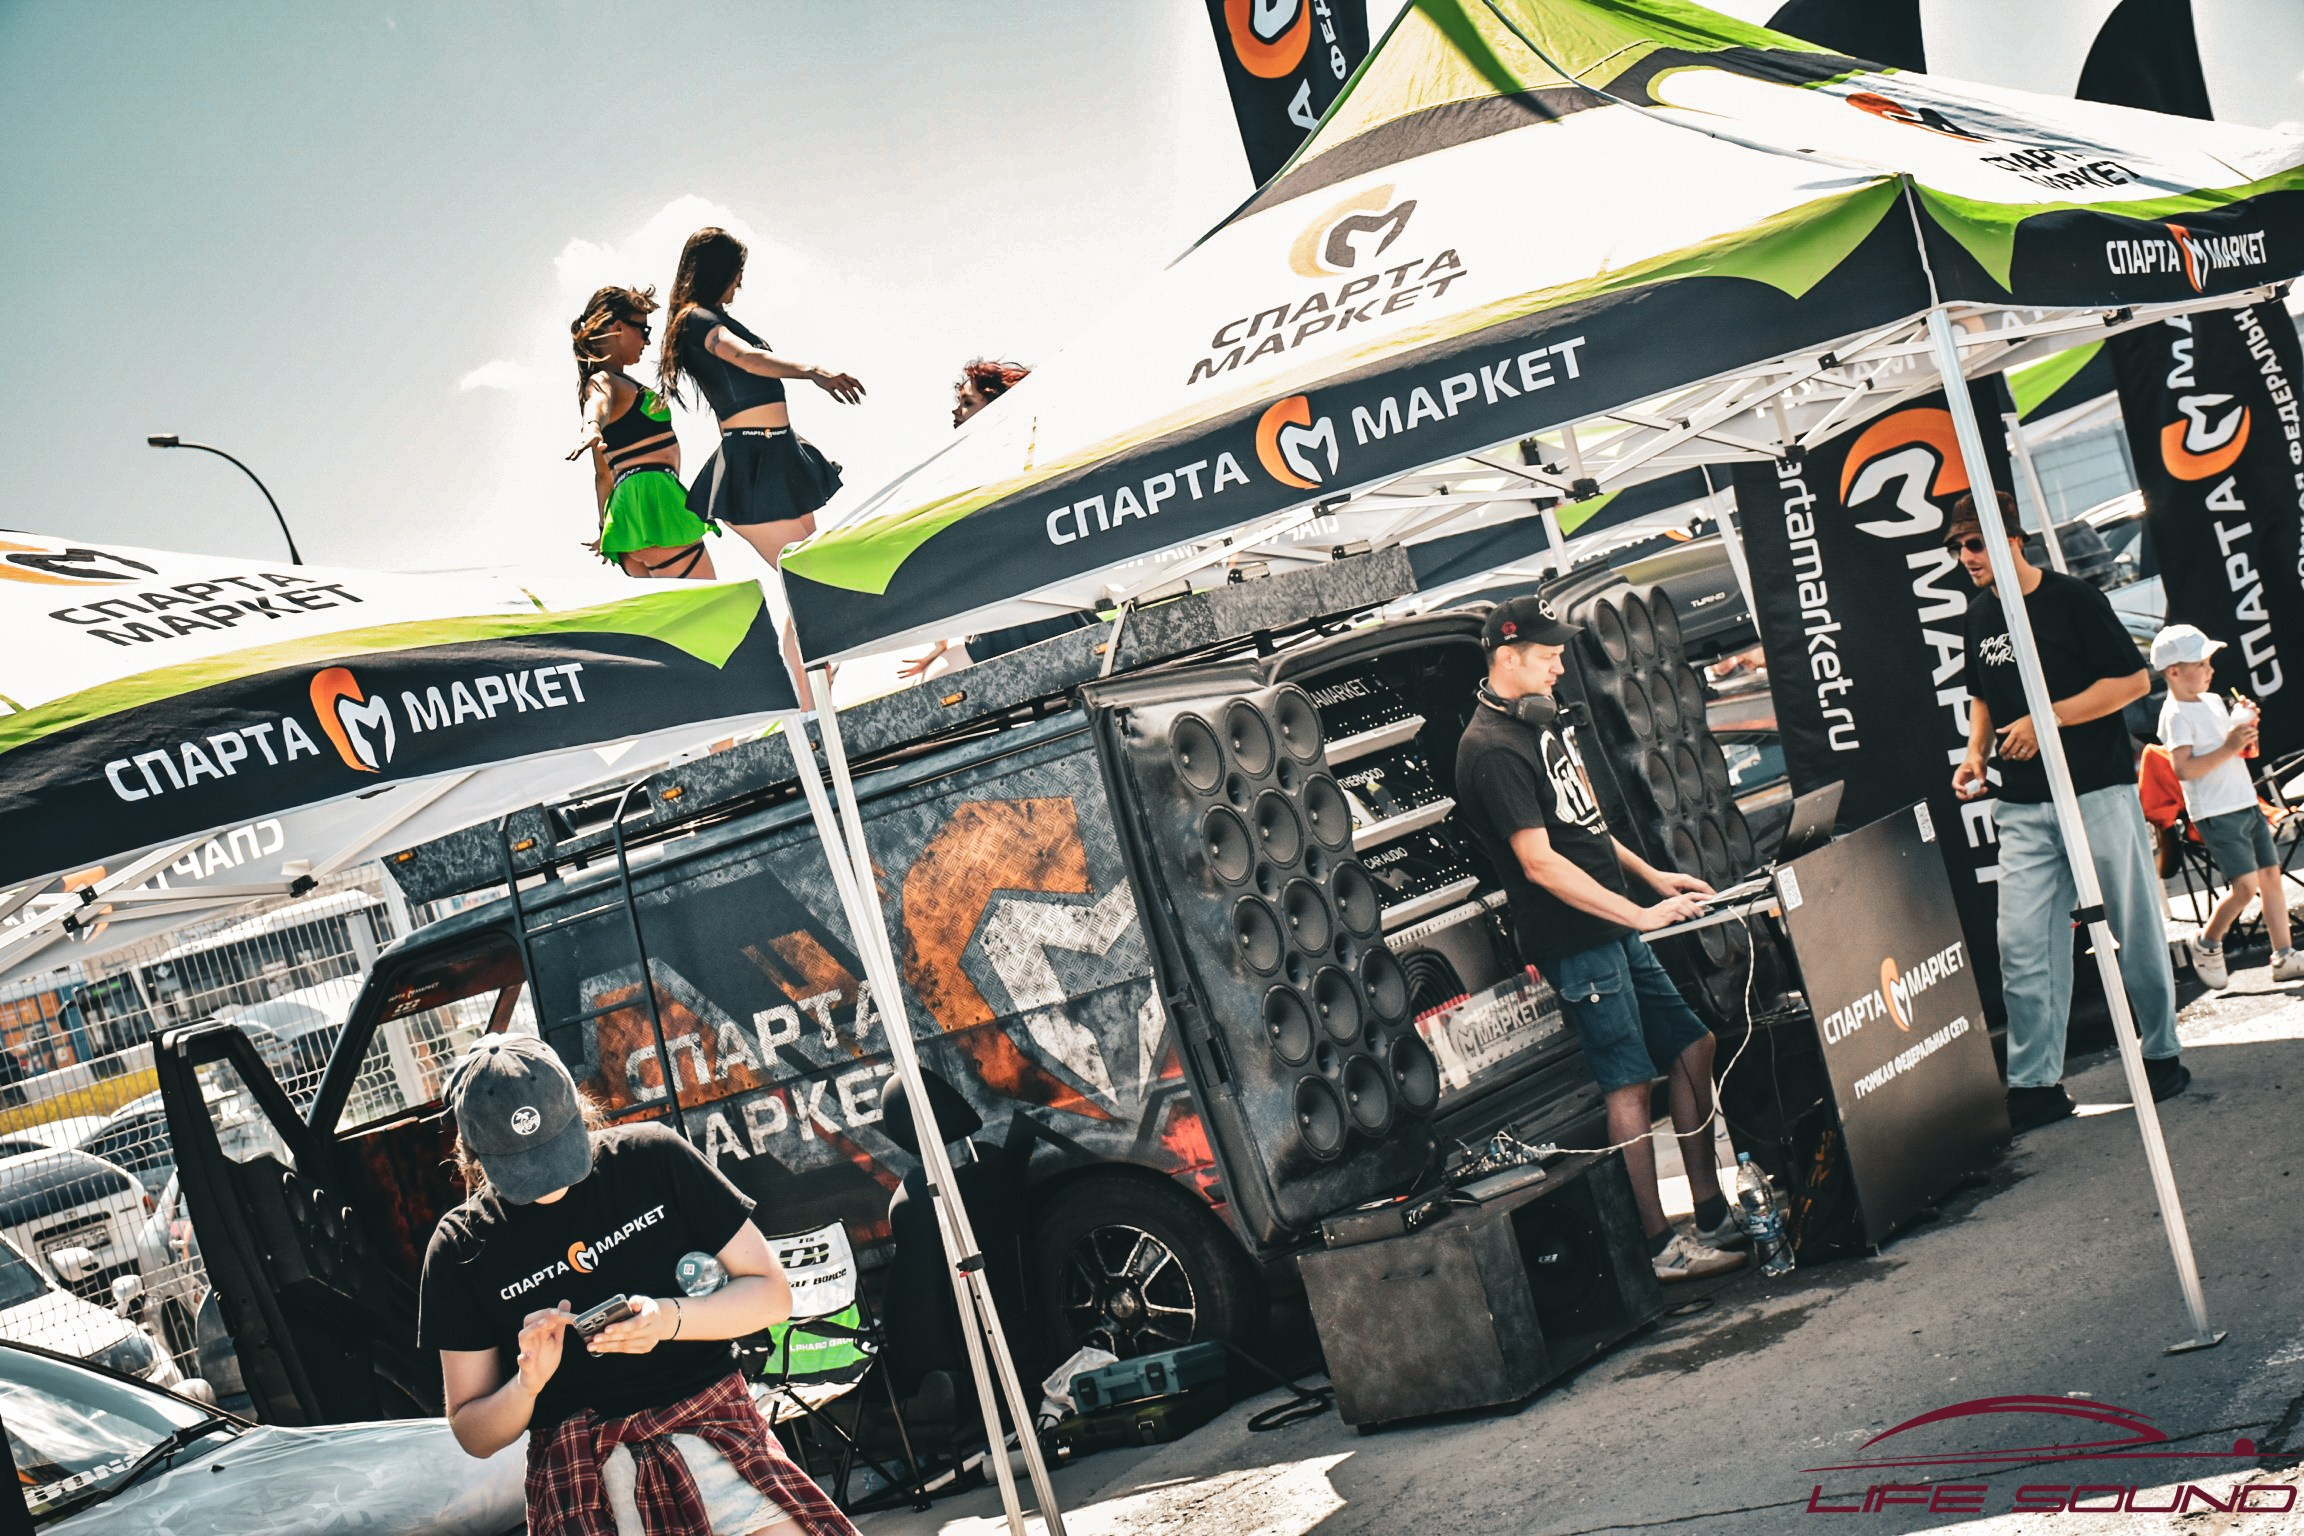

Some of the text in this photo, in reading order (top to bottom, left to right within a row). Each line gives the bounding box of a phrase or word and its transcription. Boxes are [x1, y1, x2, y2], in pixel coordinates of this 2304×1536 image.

[1979, 149, 2086, 172] СПАР
[1211, 248, 1463, 349] СПАРТА
[2106, 229, 2268, 275] СПАРТА МАРКЕТ
[1186, 269, 1468, 386] МАРКЕТ
[1045, 335, 1586, 546] СПАРТА МАРКЕТ
[49, 572, 316, 624] СПАРТА
[86, 582, 363, 646] МАРКЕТ
[2204, 475, 2284, 697] СПАРТА
[104, 662, 586, 801] СПАРТА МАРКЕТ
[1363, 846, 1409, 870] CAR AUDIO
[1823, 940, 1965, 1045] СПАРТА МАРКЕТ
[1853, 1015, 1970, 1100] ГРОМКАЯ ФЕДЕРАЛЬНАЯ СЕТЬ
[682, 1060, 900, 1168] АРКЕ
[500, 1204, 666, 1301] СПАРТА МАРКЕТ
[790, 1340, 828, 1352] LPHARD
